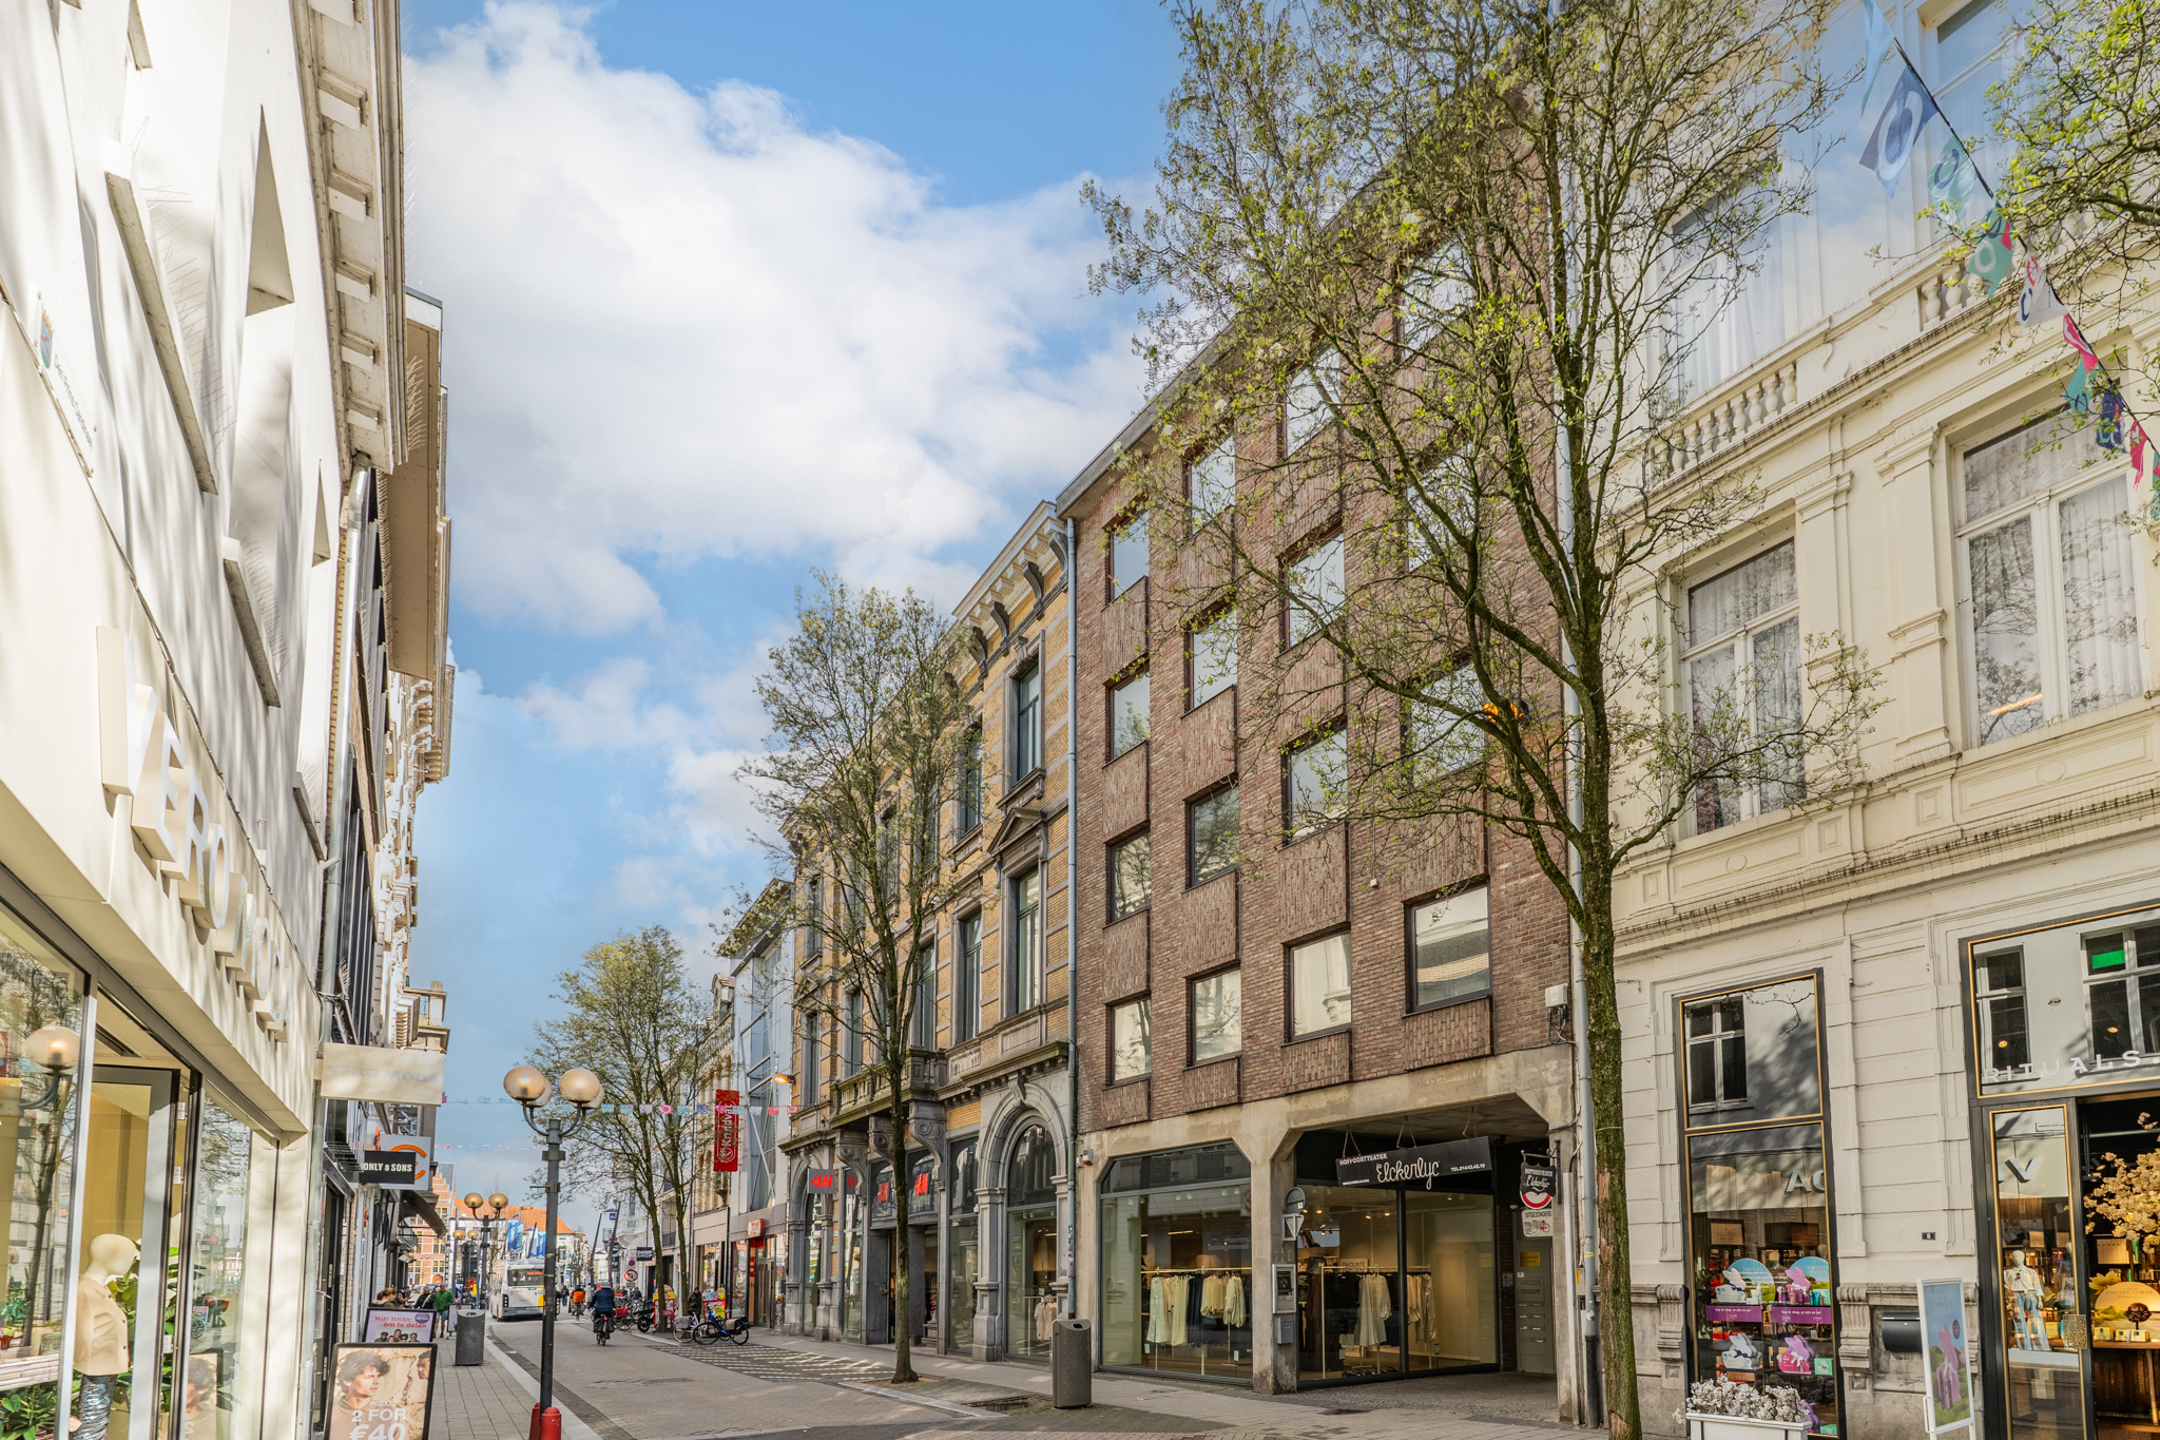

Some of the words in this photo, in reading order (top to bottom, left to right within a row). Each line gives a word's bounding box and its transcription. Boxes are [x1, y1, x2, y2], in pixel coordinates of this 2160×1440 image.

[96, 625, 230, 930] VERO
[327, 1065, 379, 1079] VERO
[384, 1070, 440, 1084] MODA
[363, 1163, 383, 1172] ONLY
[391, 1163, 412, 1172] SONS
[1375, 1157, 1440, 1190] Elckerlyc
[811, 1174, 833, 1189] H&M
[914, 1173, 929, 1196] H&M
[351, 1410, 362, 1422] 2
[368, 1408, 406, 1422] FOR
[350, 1423, 406, 1440] €40
